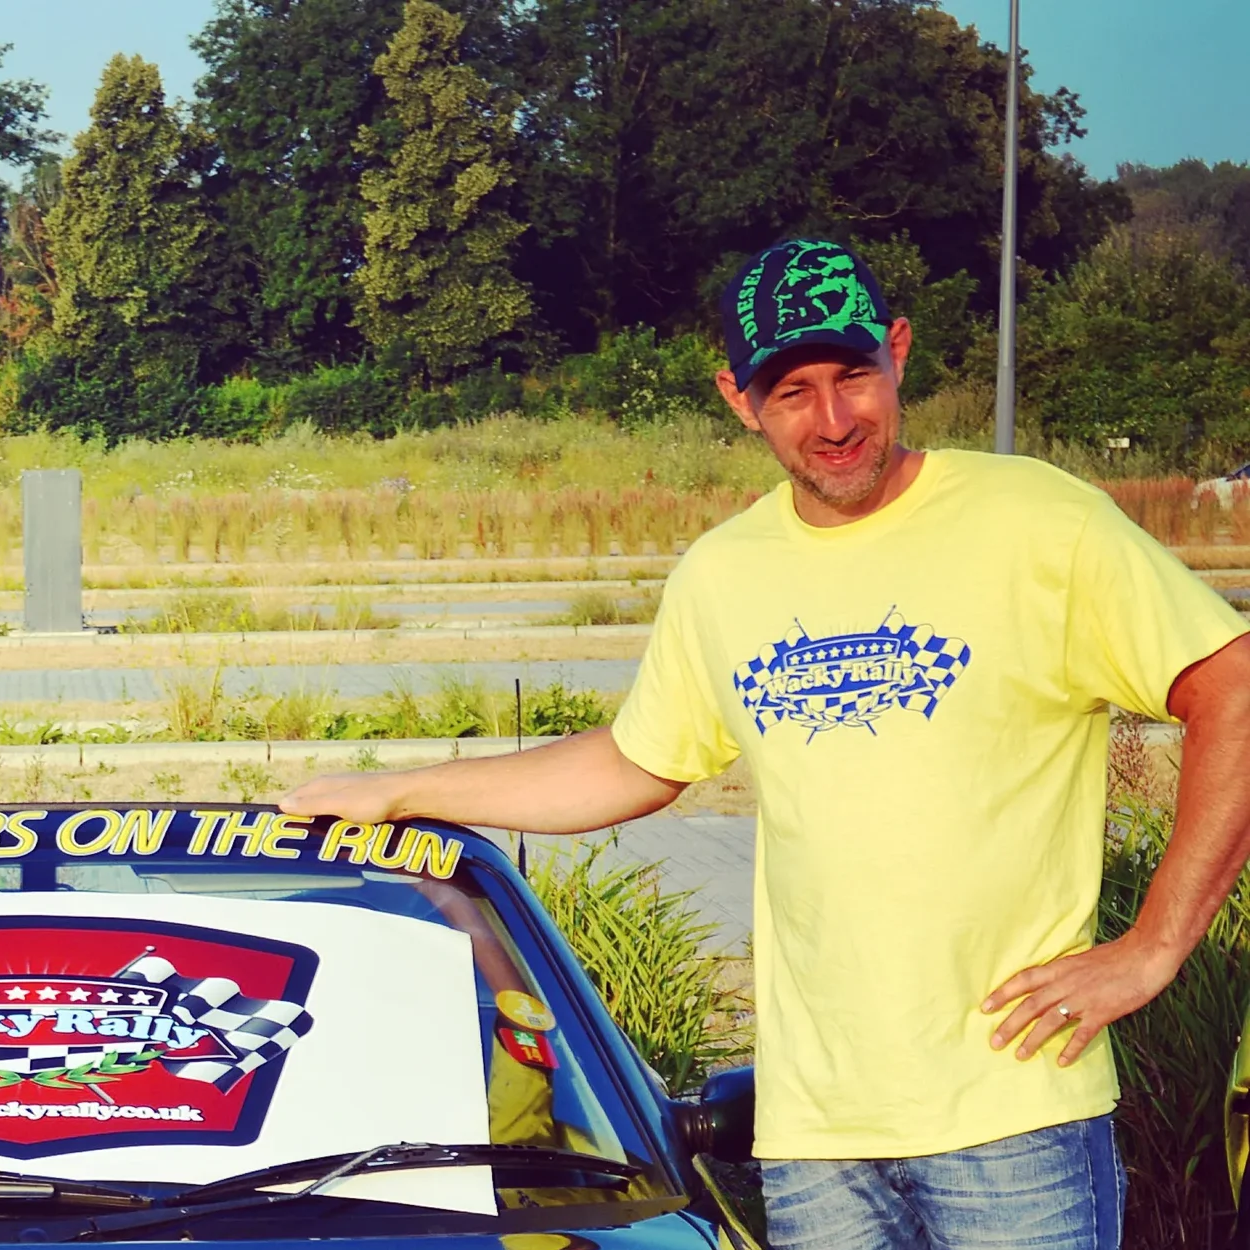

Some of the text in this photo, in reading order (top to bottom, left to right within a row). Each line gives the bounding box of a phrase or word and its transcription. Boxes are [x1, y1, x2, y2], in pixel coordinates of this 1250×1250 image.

[737, 263, 764, 341] DIESEL
[767, 660, 920, 698] Wacky Rally
[55, 808, 176, 856] ON
[187, 809, 316, 860] THE
[317, 818, 465, 880] RUN
[52, 1009, 209, 1050] Rally
